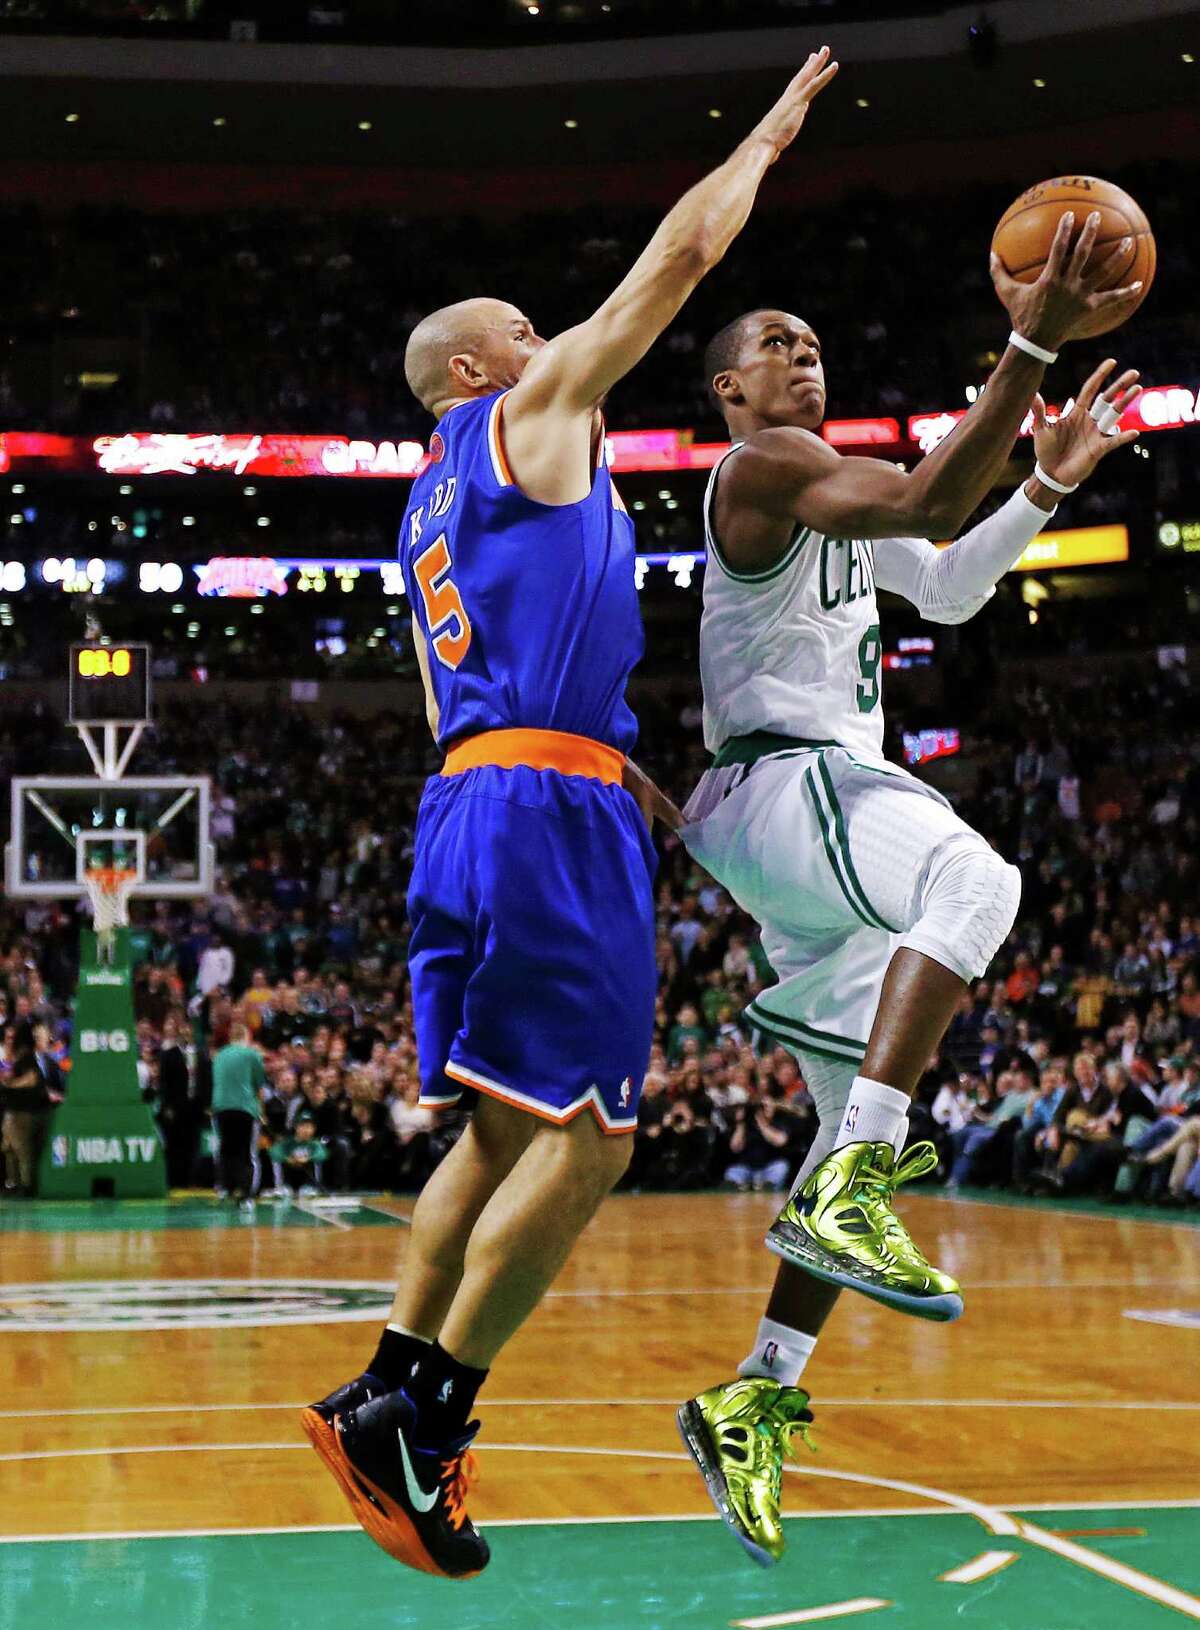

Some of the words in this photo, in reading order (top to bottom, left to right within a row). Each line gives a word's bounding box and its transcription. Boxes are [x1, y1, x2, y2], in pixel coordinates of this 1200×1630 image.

[413, 532, 472, 672] 5
[856, 624, 881, 714] 9
[76, 1137, 124, 1163] NBA
[124, 1137, 157, 1163] TV
